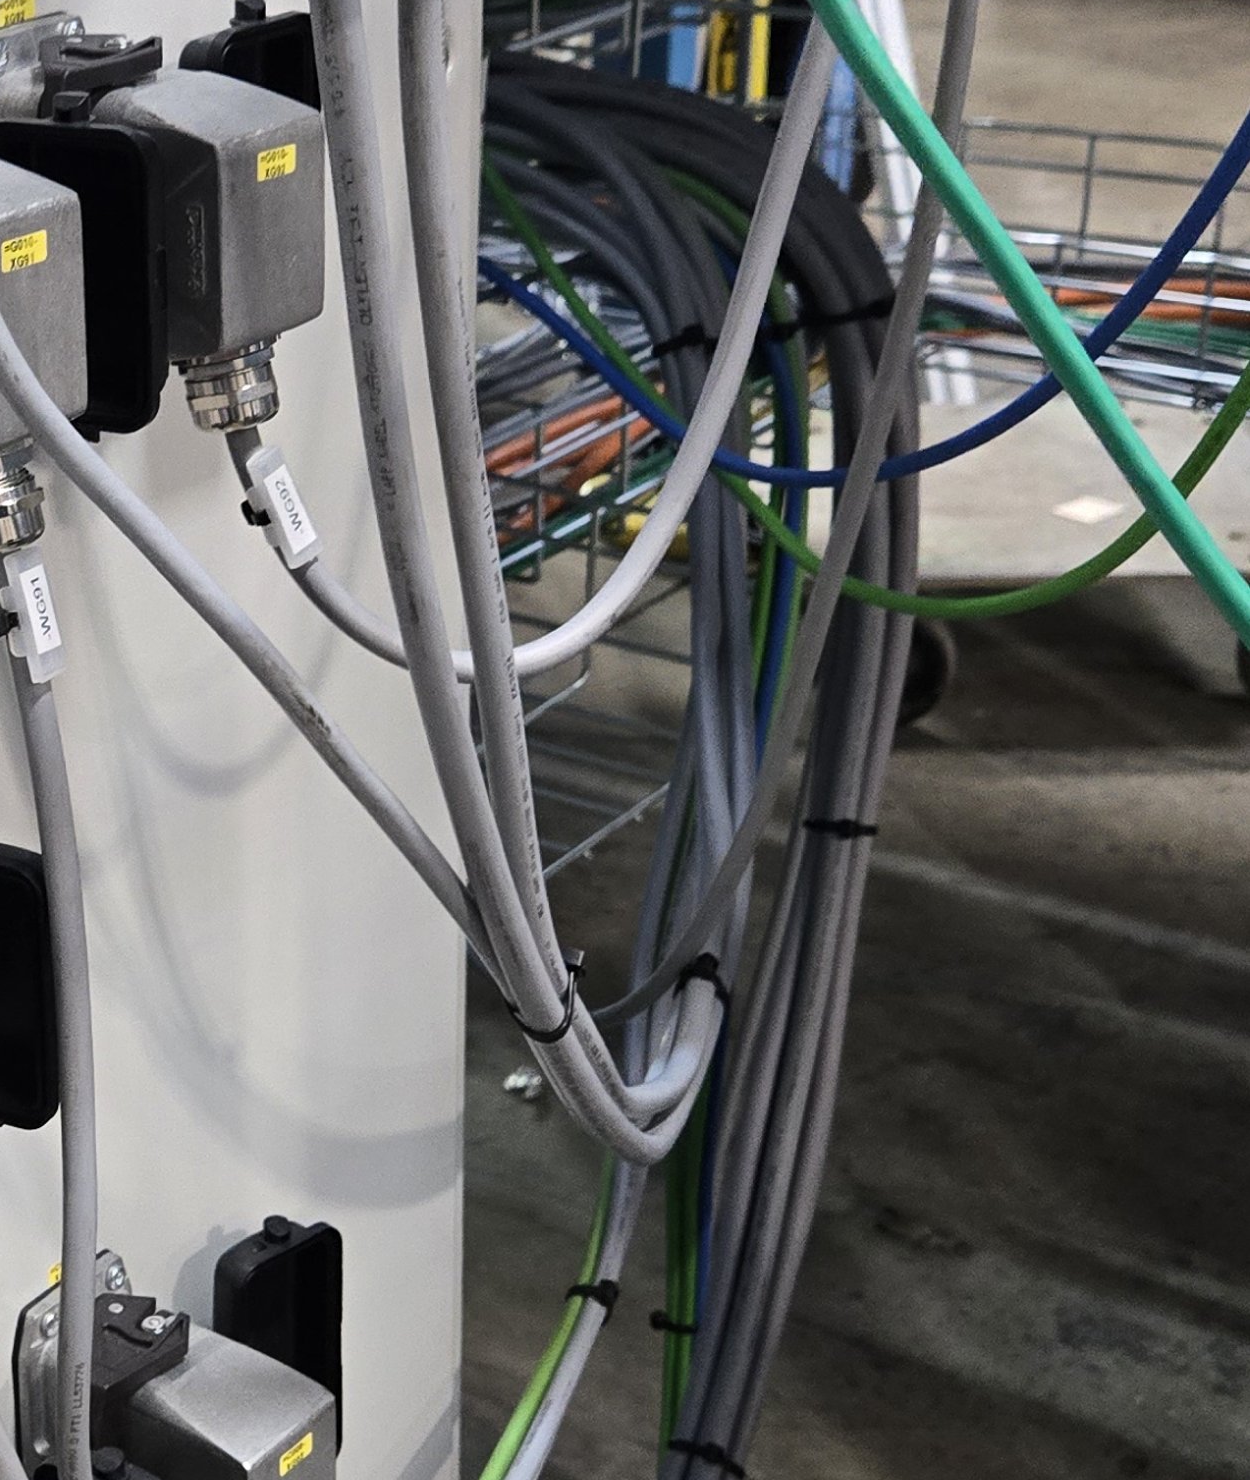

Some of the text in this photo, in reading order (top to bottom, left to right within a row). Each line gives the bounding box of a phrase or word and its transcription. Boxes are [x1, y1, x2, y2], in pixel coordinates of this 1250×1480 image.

[4, 236, 39, 253] =G010-
[275, 479, 305, 534] -WG92
[30, 576, 52, 641] -WG91
